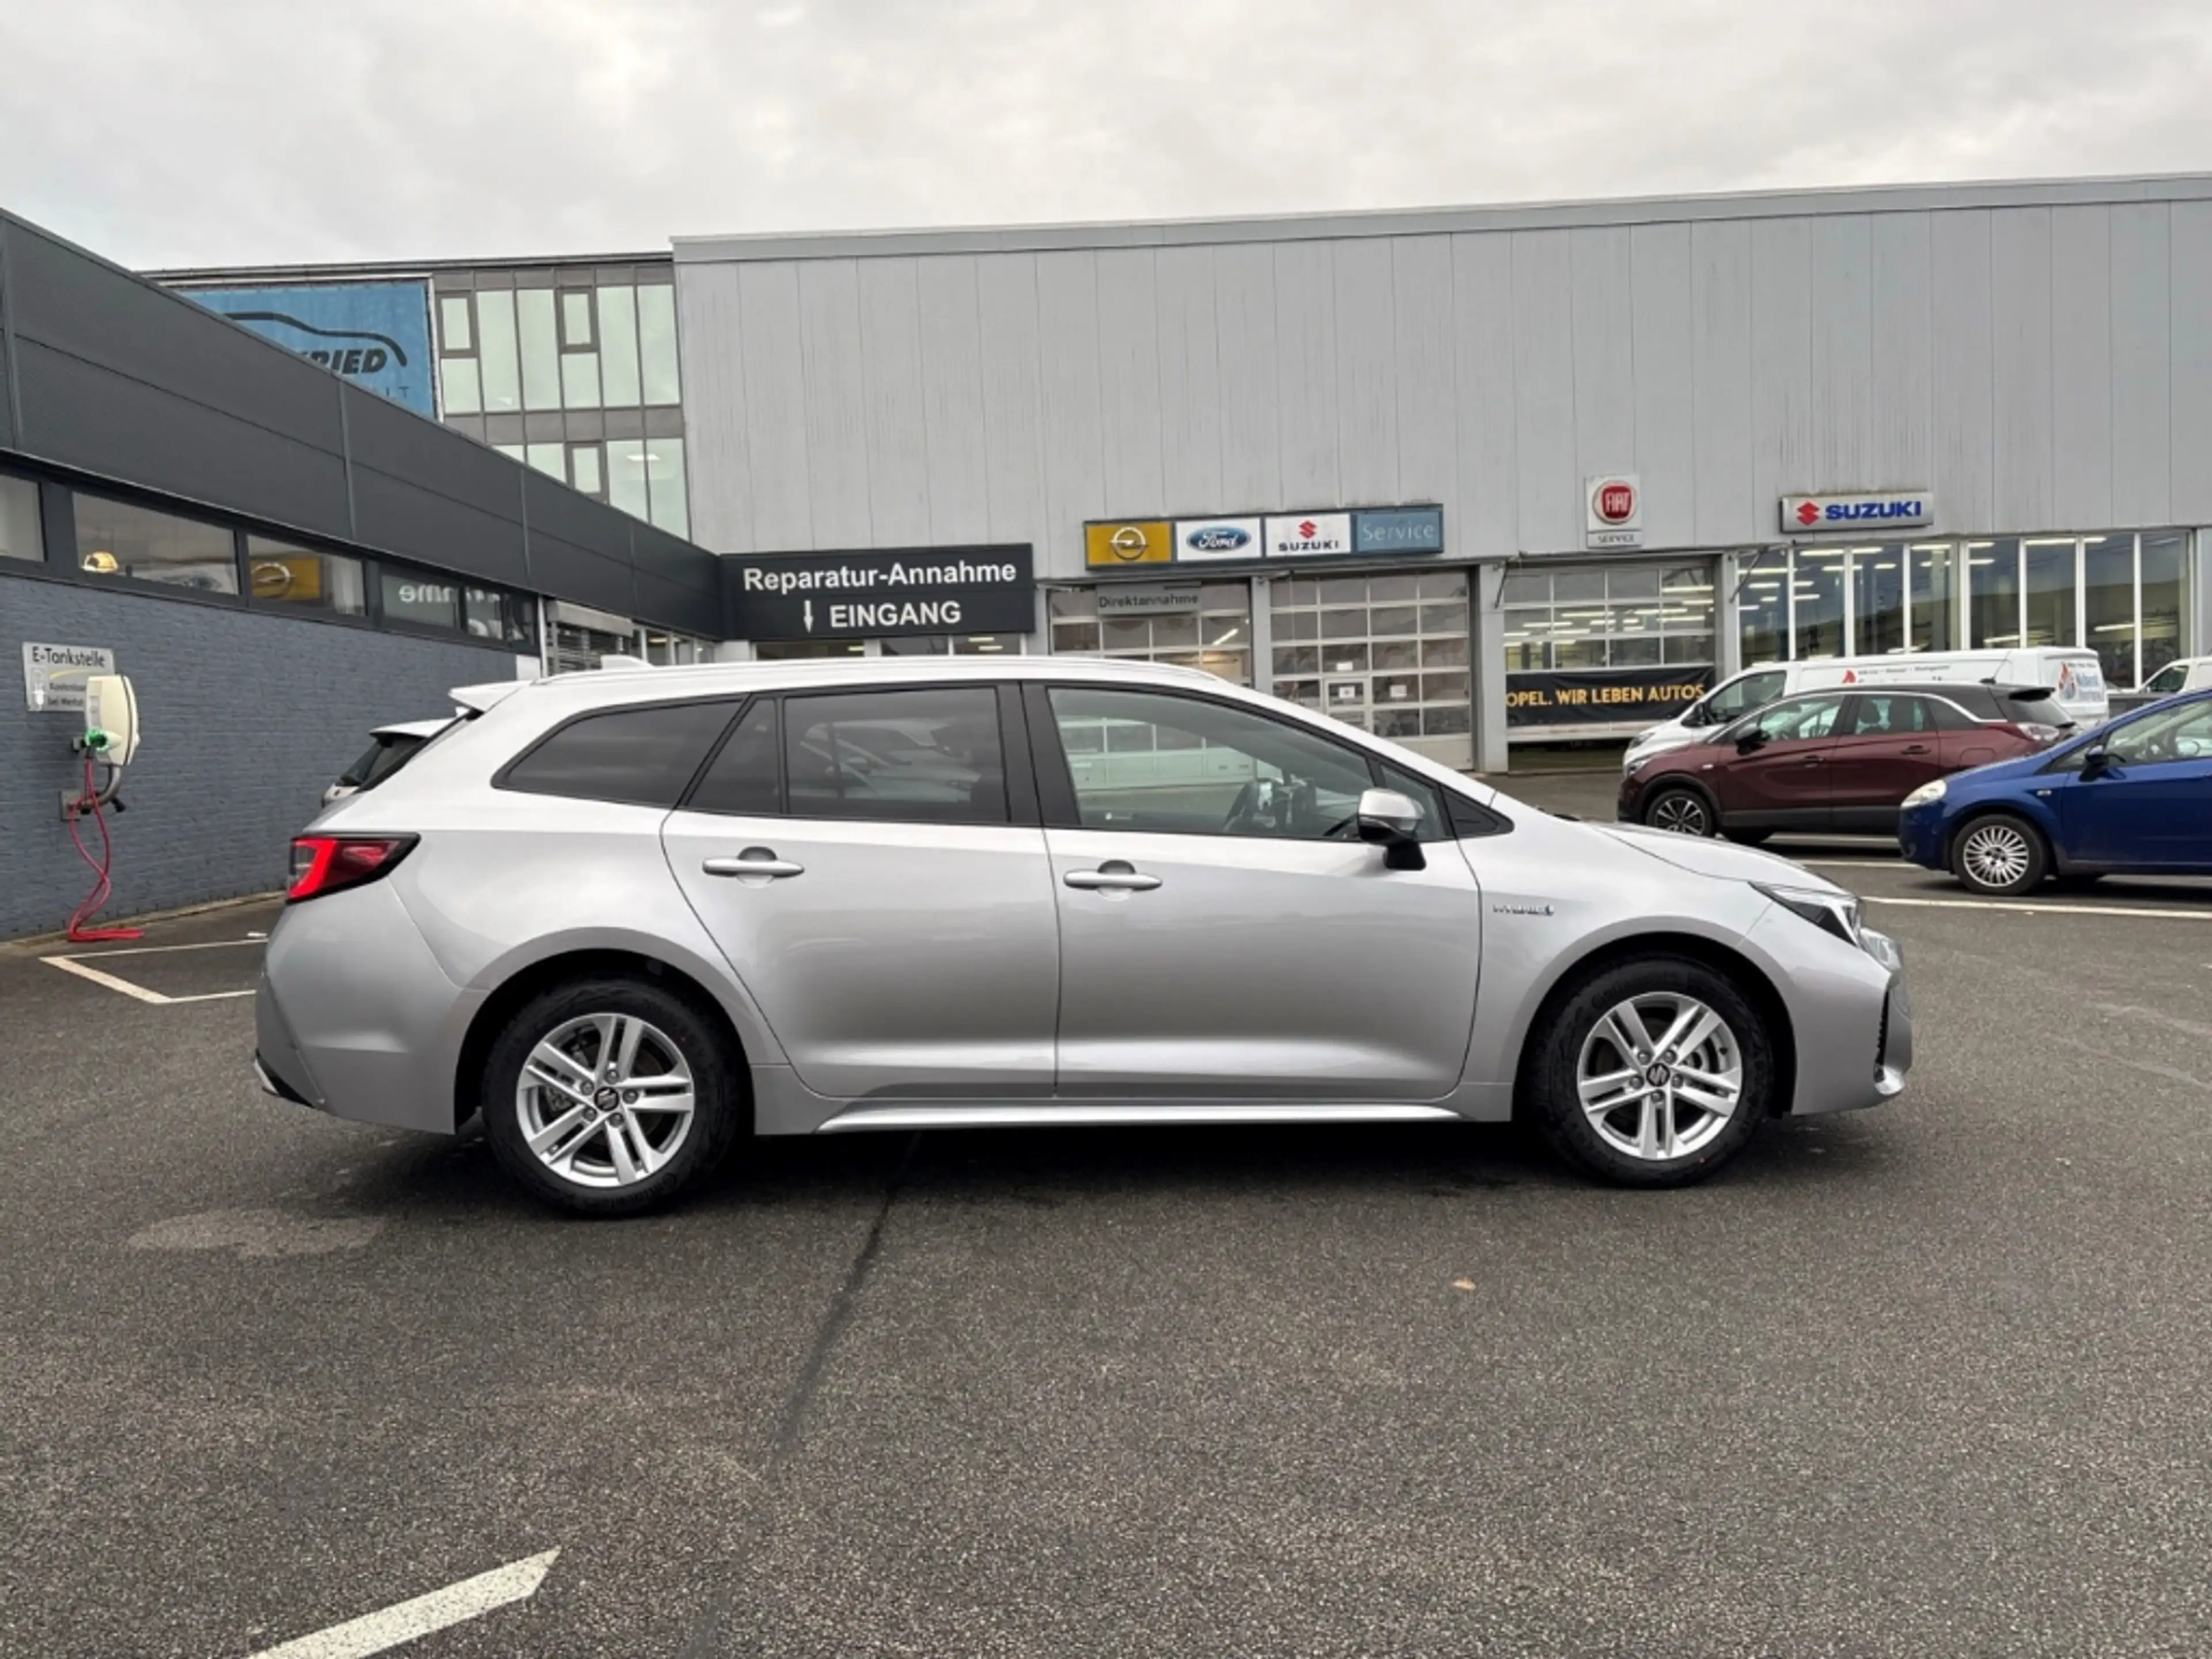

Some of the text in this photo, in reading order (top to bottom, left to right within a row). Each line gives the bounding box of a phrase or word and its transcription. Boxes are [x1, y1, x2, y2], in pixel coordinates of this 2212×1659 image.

[1605, 492, 1631, 512] FIAT
[1825, 500, 1921, 521] SUZUKI
[1198, 531, 1238, 548] Ford
[1362, 520, 1434, 541] Service
[1278, 539, 1339, 551] SUZUKI
[743, 560, 1017, 595] Reparatur-Annahme
[1099, 594, 1199, 608] Direktannahme
[830, 600, 961, 628] EINGANG
[32, 646, 105, 668] E-Tankstelle
[1506, 684, 1705, 707] OPEL. WIR LEBEN AUTOS
